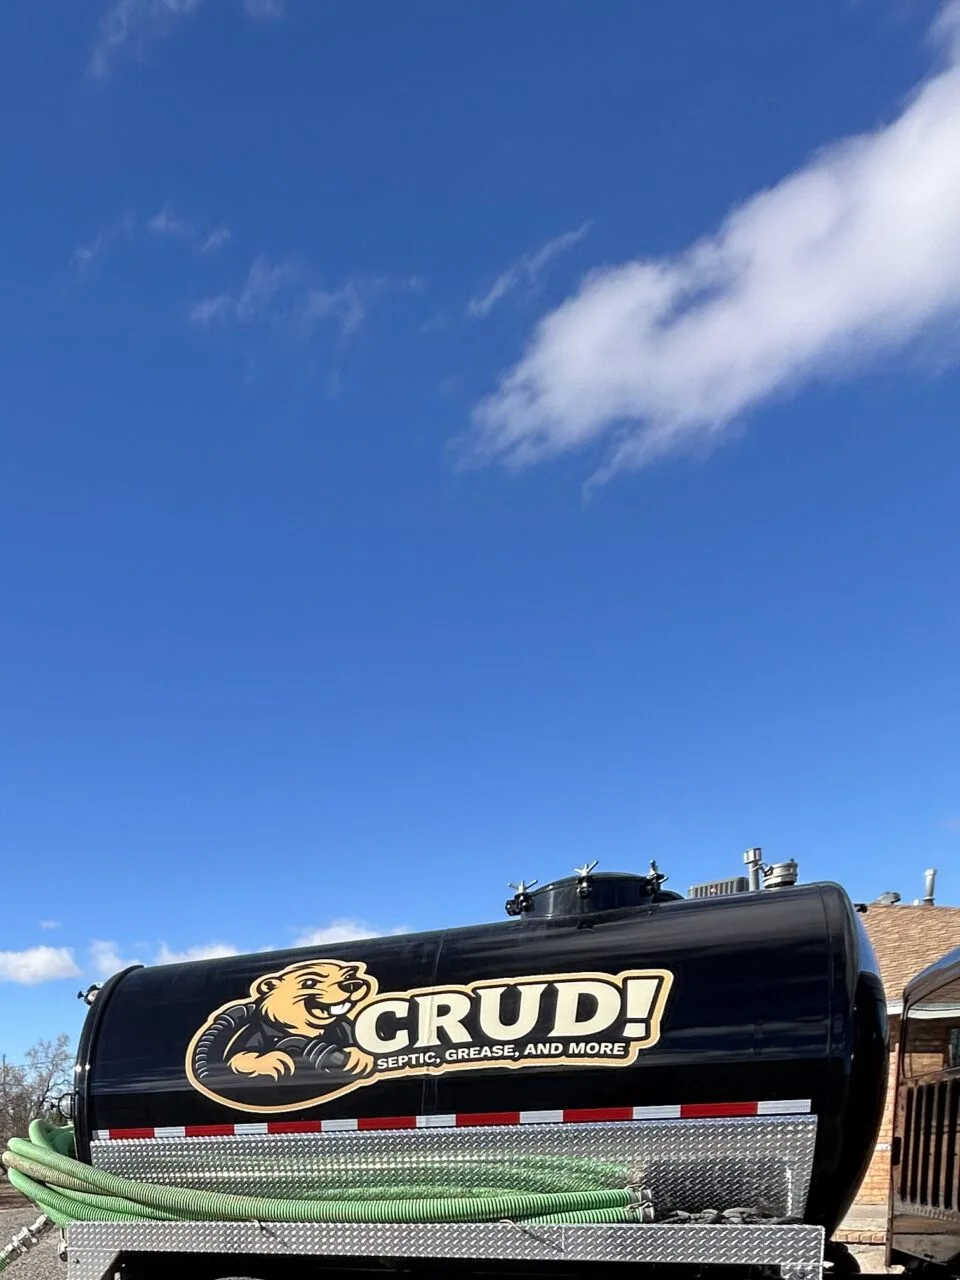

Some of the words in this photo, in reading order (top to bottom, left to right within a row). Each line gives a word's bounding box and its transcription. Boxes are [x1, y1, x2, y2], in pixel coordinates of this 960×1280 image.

[355, 978, 659, 1053] CRUD!
[377, 1052, 440, 1069] SEPTIC,
[445, 1045, 519, 1060] GREASE,
[524, 1042, 563, 1056] AND
[569, 1042, 626, 1055] MORE
